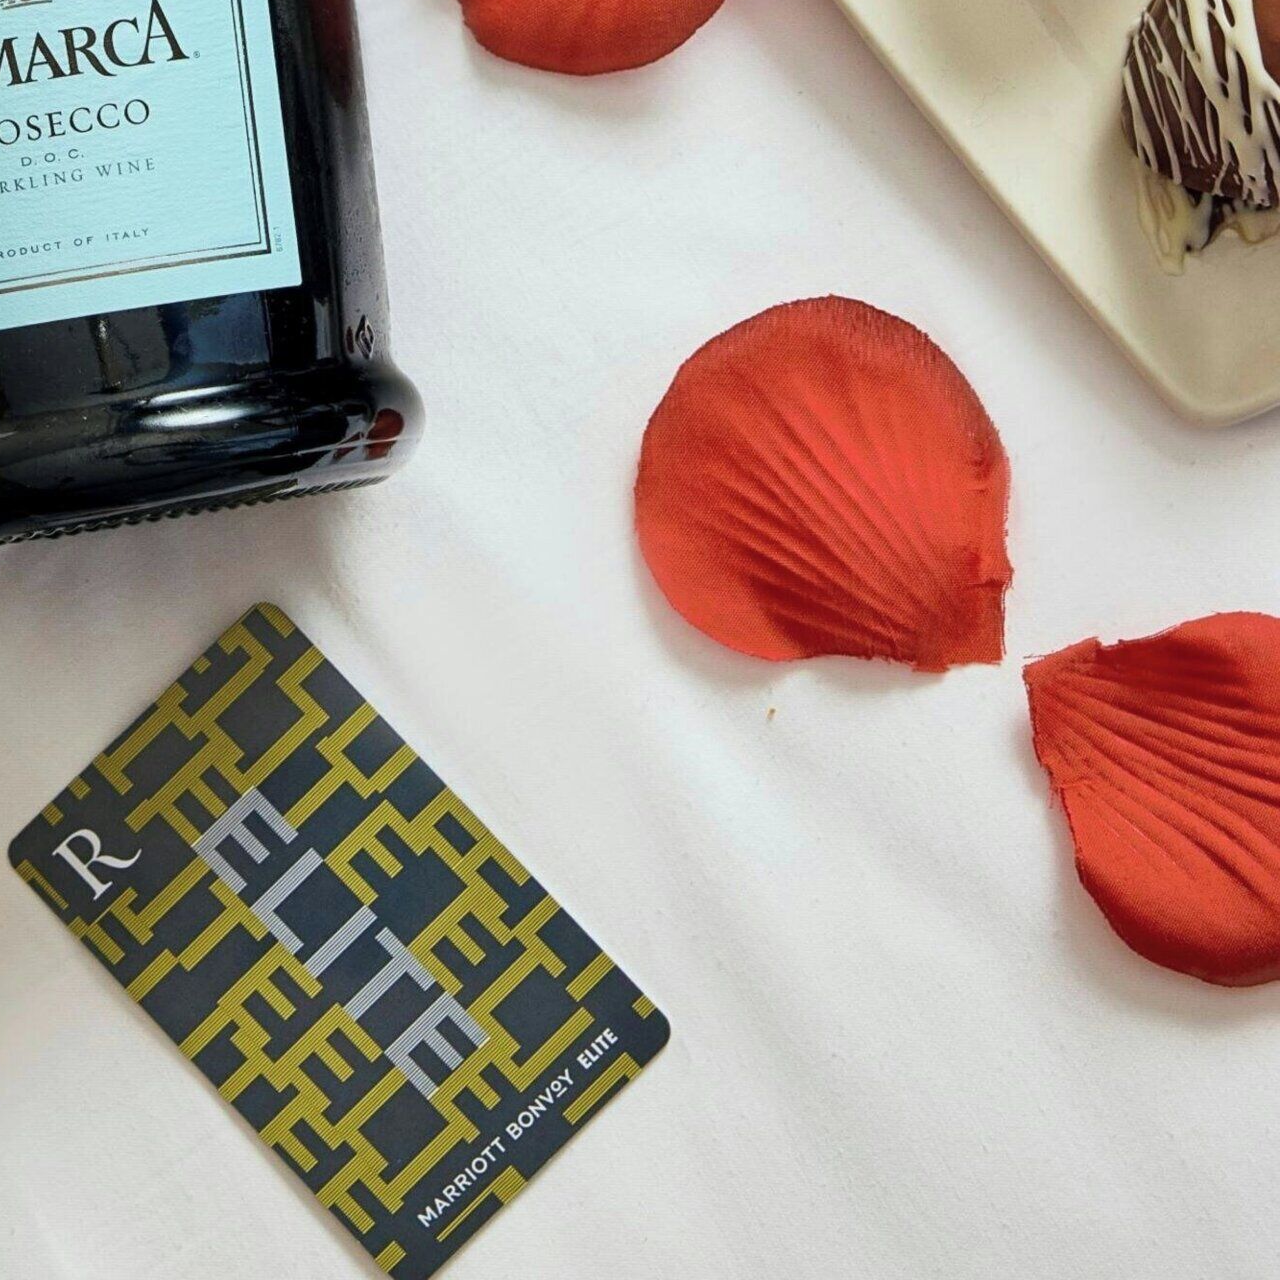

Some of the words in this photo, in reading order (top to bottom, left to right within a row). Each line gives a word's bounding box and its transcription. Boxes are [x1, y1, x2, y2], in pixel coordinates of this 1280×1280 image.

[95, 157, 157, 178] WINE
[73, 235, 95, 248] OF
[104, 227, 151, 244] ITALY
[52, 827, 142, 902] R
[191, 785, 490, 1100] ELITE
[417, 1136, 507, 1229] MARRIOTT
[505, 1068, 576, 1141] BONVOY
[576, 1027, 619, 1070] ELITE
